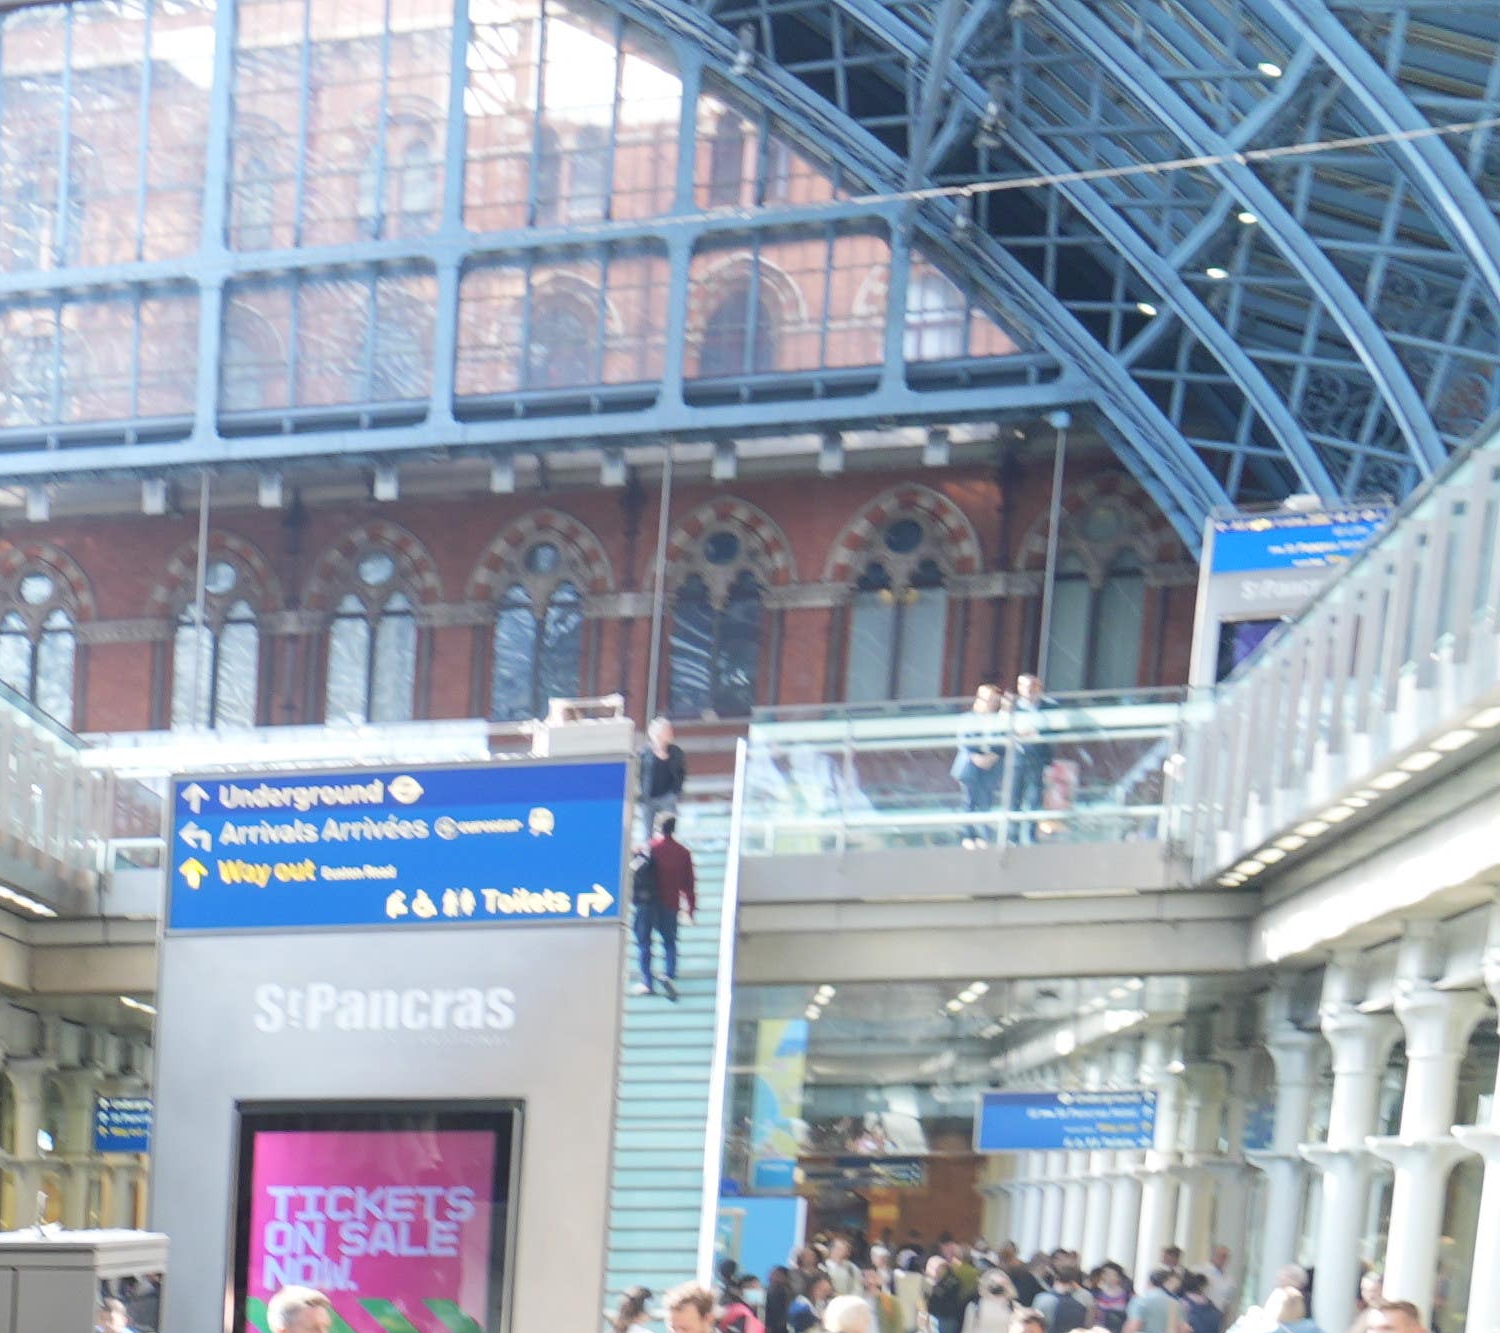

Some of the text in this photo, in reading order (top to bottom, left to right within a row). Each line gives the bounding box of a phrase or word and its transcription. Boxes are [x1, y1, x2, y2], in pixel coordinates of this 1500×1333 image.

[219, 779, 384, 812] Underground
[219, 819, 319, 847] Arrivals
[321, 814, 430, 842] Arrivées
[217, 858, 272, 888] Way
[273, 859, 316, 882] out
[480, 887, 571, 914] Toilets
[305, 981, 518, 1032] Pancras
[266, 1186, 477, 1223] TICKETS
[264, 1220, 461, 1257] ON SALE
[263, 1255, 359, 1291] NOW.
